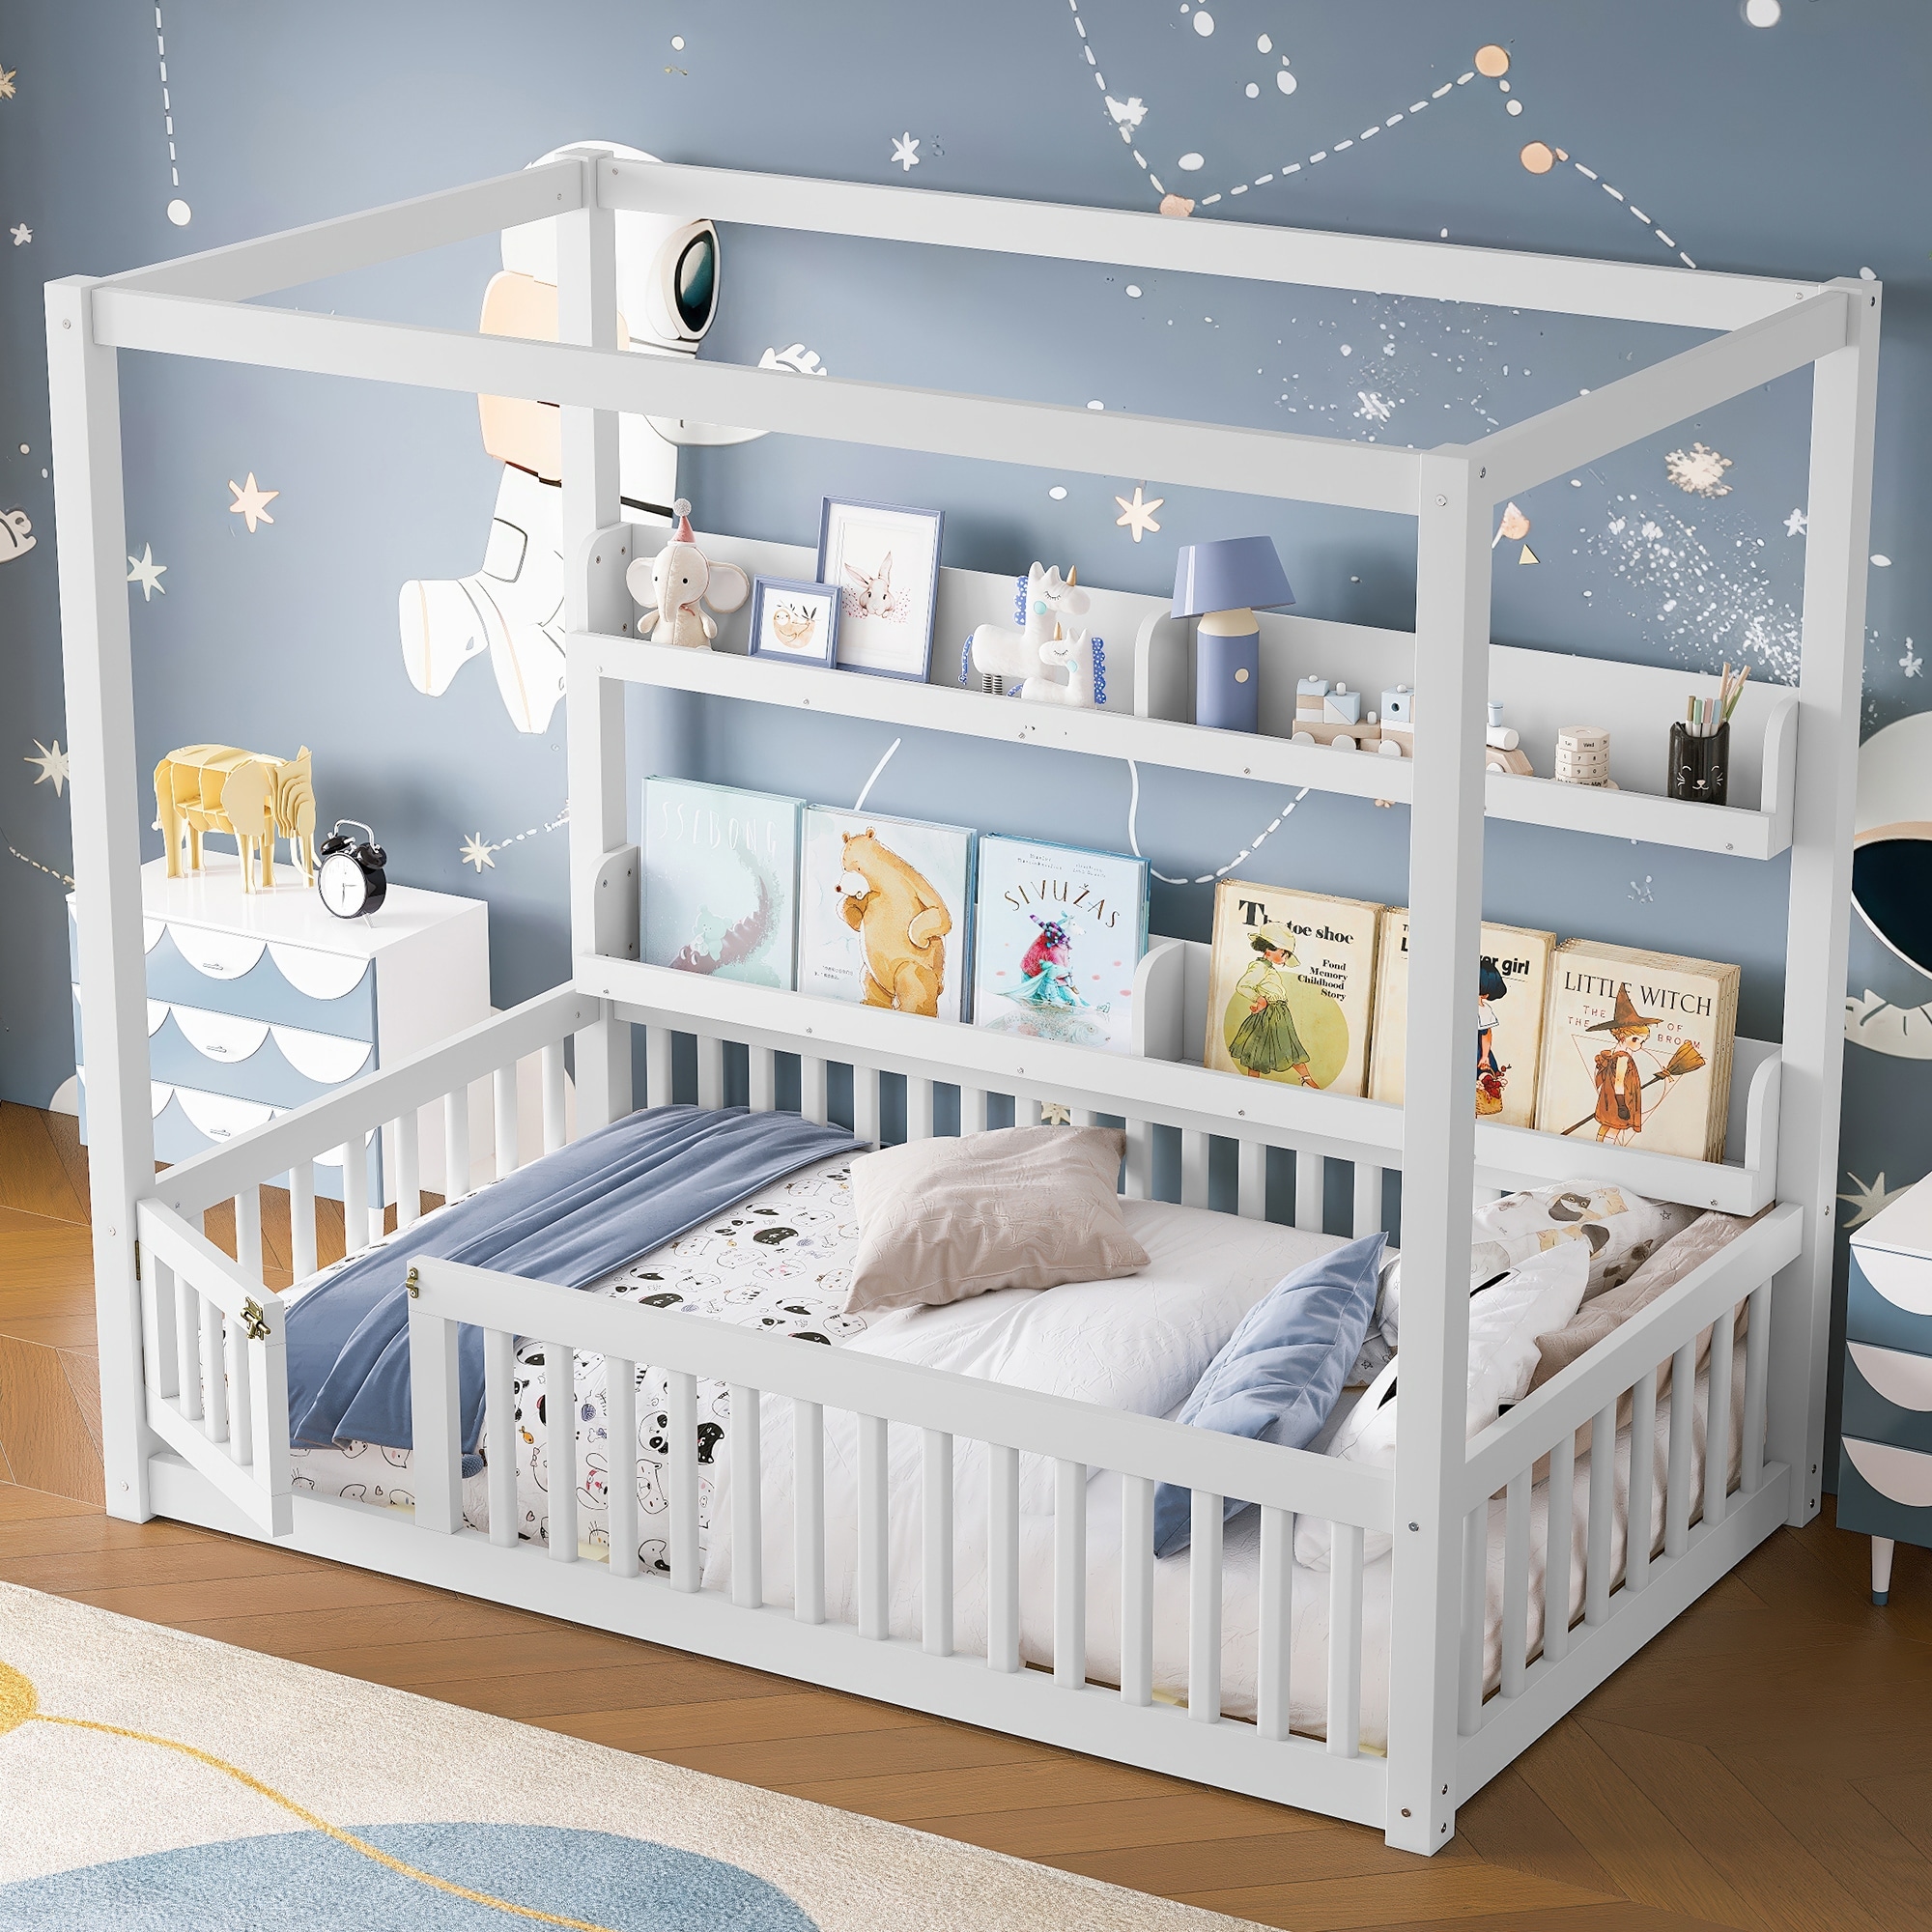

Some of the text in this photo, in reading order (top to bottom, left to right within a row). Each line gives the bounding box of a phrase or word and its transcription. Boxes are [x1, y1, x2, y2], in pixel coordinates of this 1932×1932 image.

[1004, 879, 1121, 928] SIVUŽAS
[1322, 958, 1347, 971] Fond
[1501, 957, 1530, 976] girl
[1309, 966, 1349, 980] Memory
[1297, 974, 1345, 990] Childhood
[1321, 987, 1347, 1002] Story
[1639, 984, 1713, 1016] WITCH
[1567, 1015, 1590, 1028] THE
[1582, 1005, 1606, 1018] THE
[1666, 1022, 1684, 1033] OF
